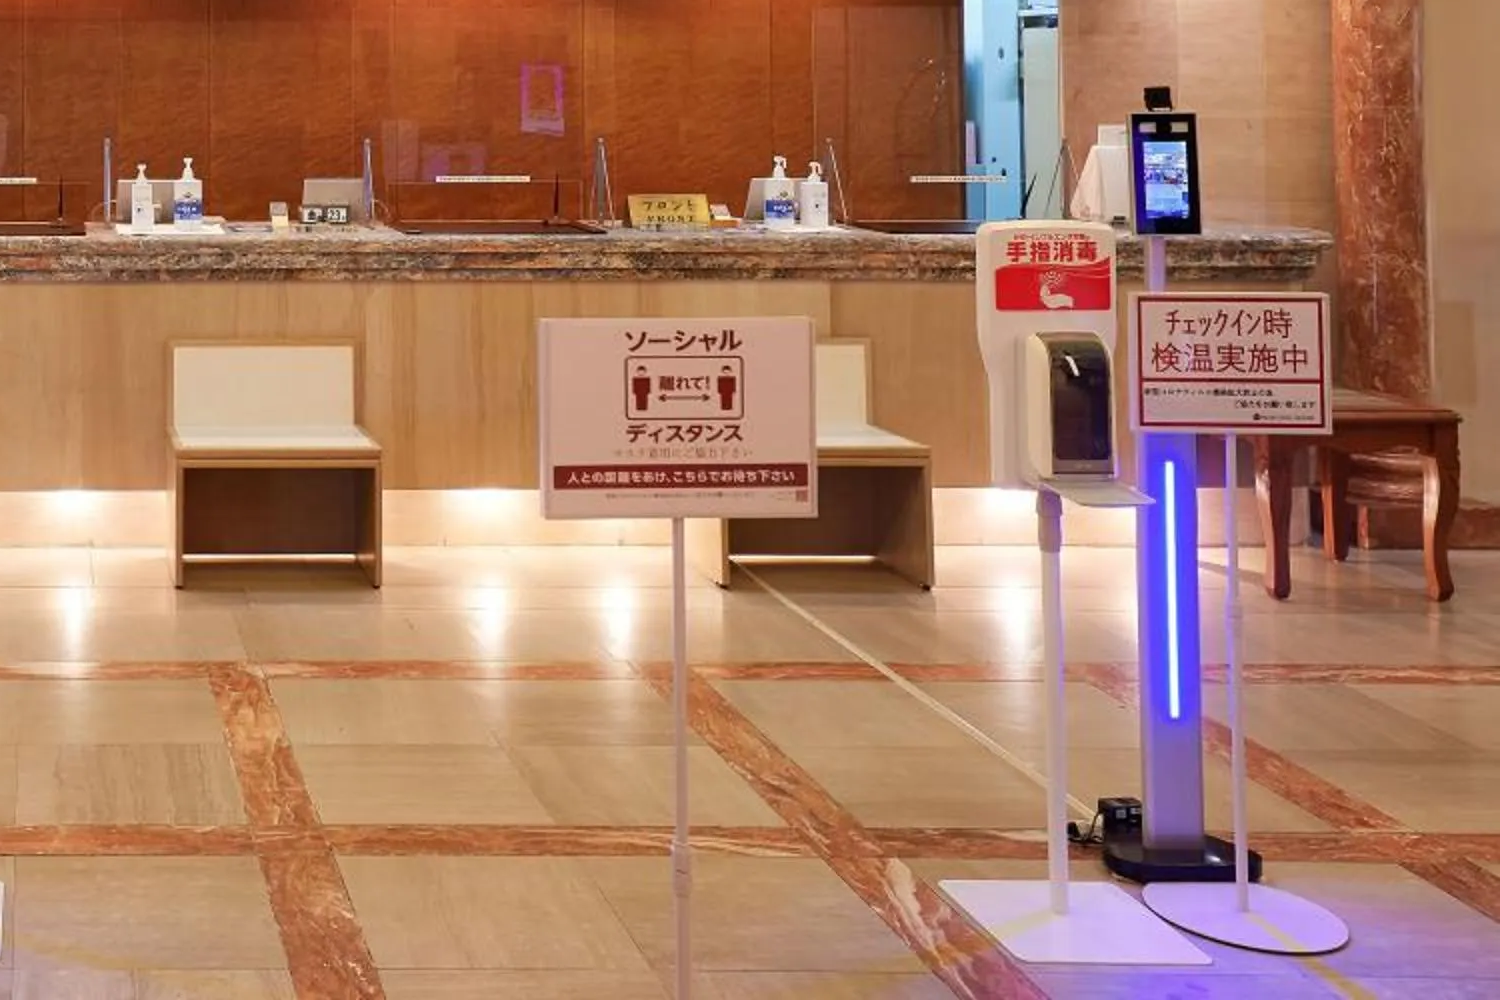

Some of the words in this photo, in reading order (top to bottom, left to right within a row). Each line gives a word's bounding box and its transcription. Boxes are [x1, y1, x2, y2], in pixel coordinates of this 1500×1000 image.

[1006, 242, 1097, 262] 手指消毒
[1165, 308, 1293, 339] チェックイン時
[625, 329, 742, 352] ソーシャル
[1151, 342, 1308, 374] 検温実施中
[626, 423, 743, 443] ディスタンス
